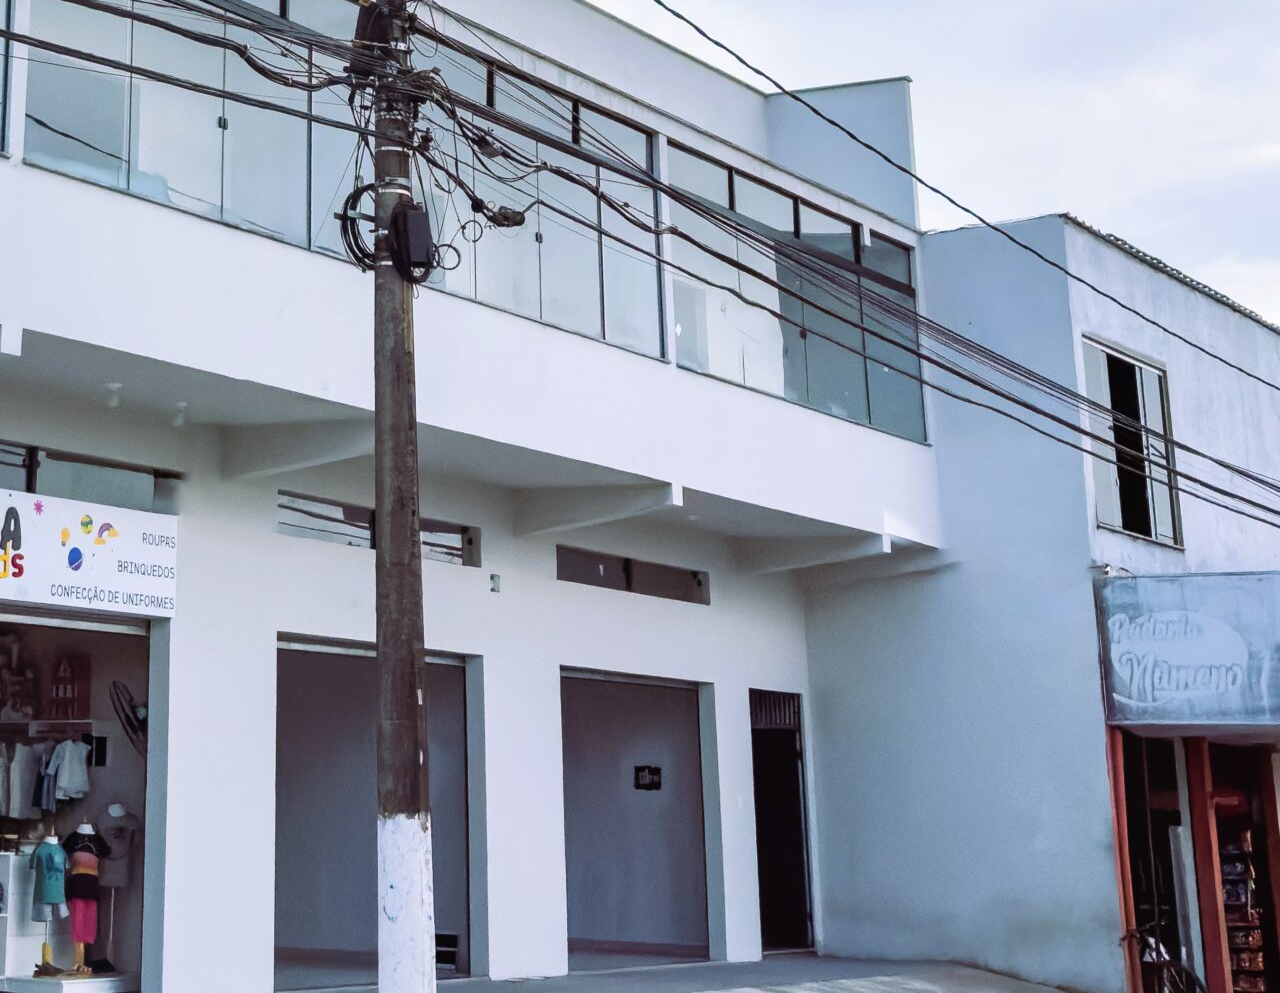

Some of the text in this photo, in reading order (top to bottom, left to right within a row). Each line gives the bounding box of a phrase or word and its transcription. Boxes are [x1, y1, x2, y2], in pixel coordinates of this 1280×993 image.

[141, 531, 176, 549] ROUPAS
[117, 560, 176, 580] BRINQUEDOS
[50, 583, 175, 610] CONFECÇÃO DE UNIFORMES
